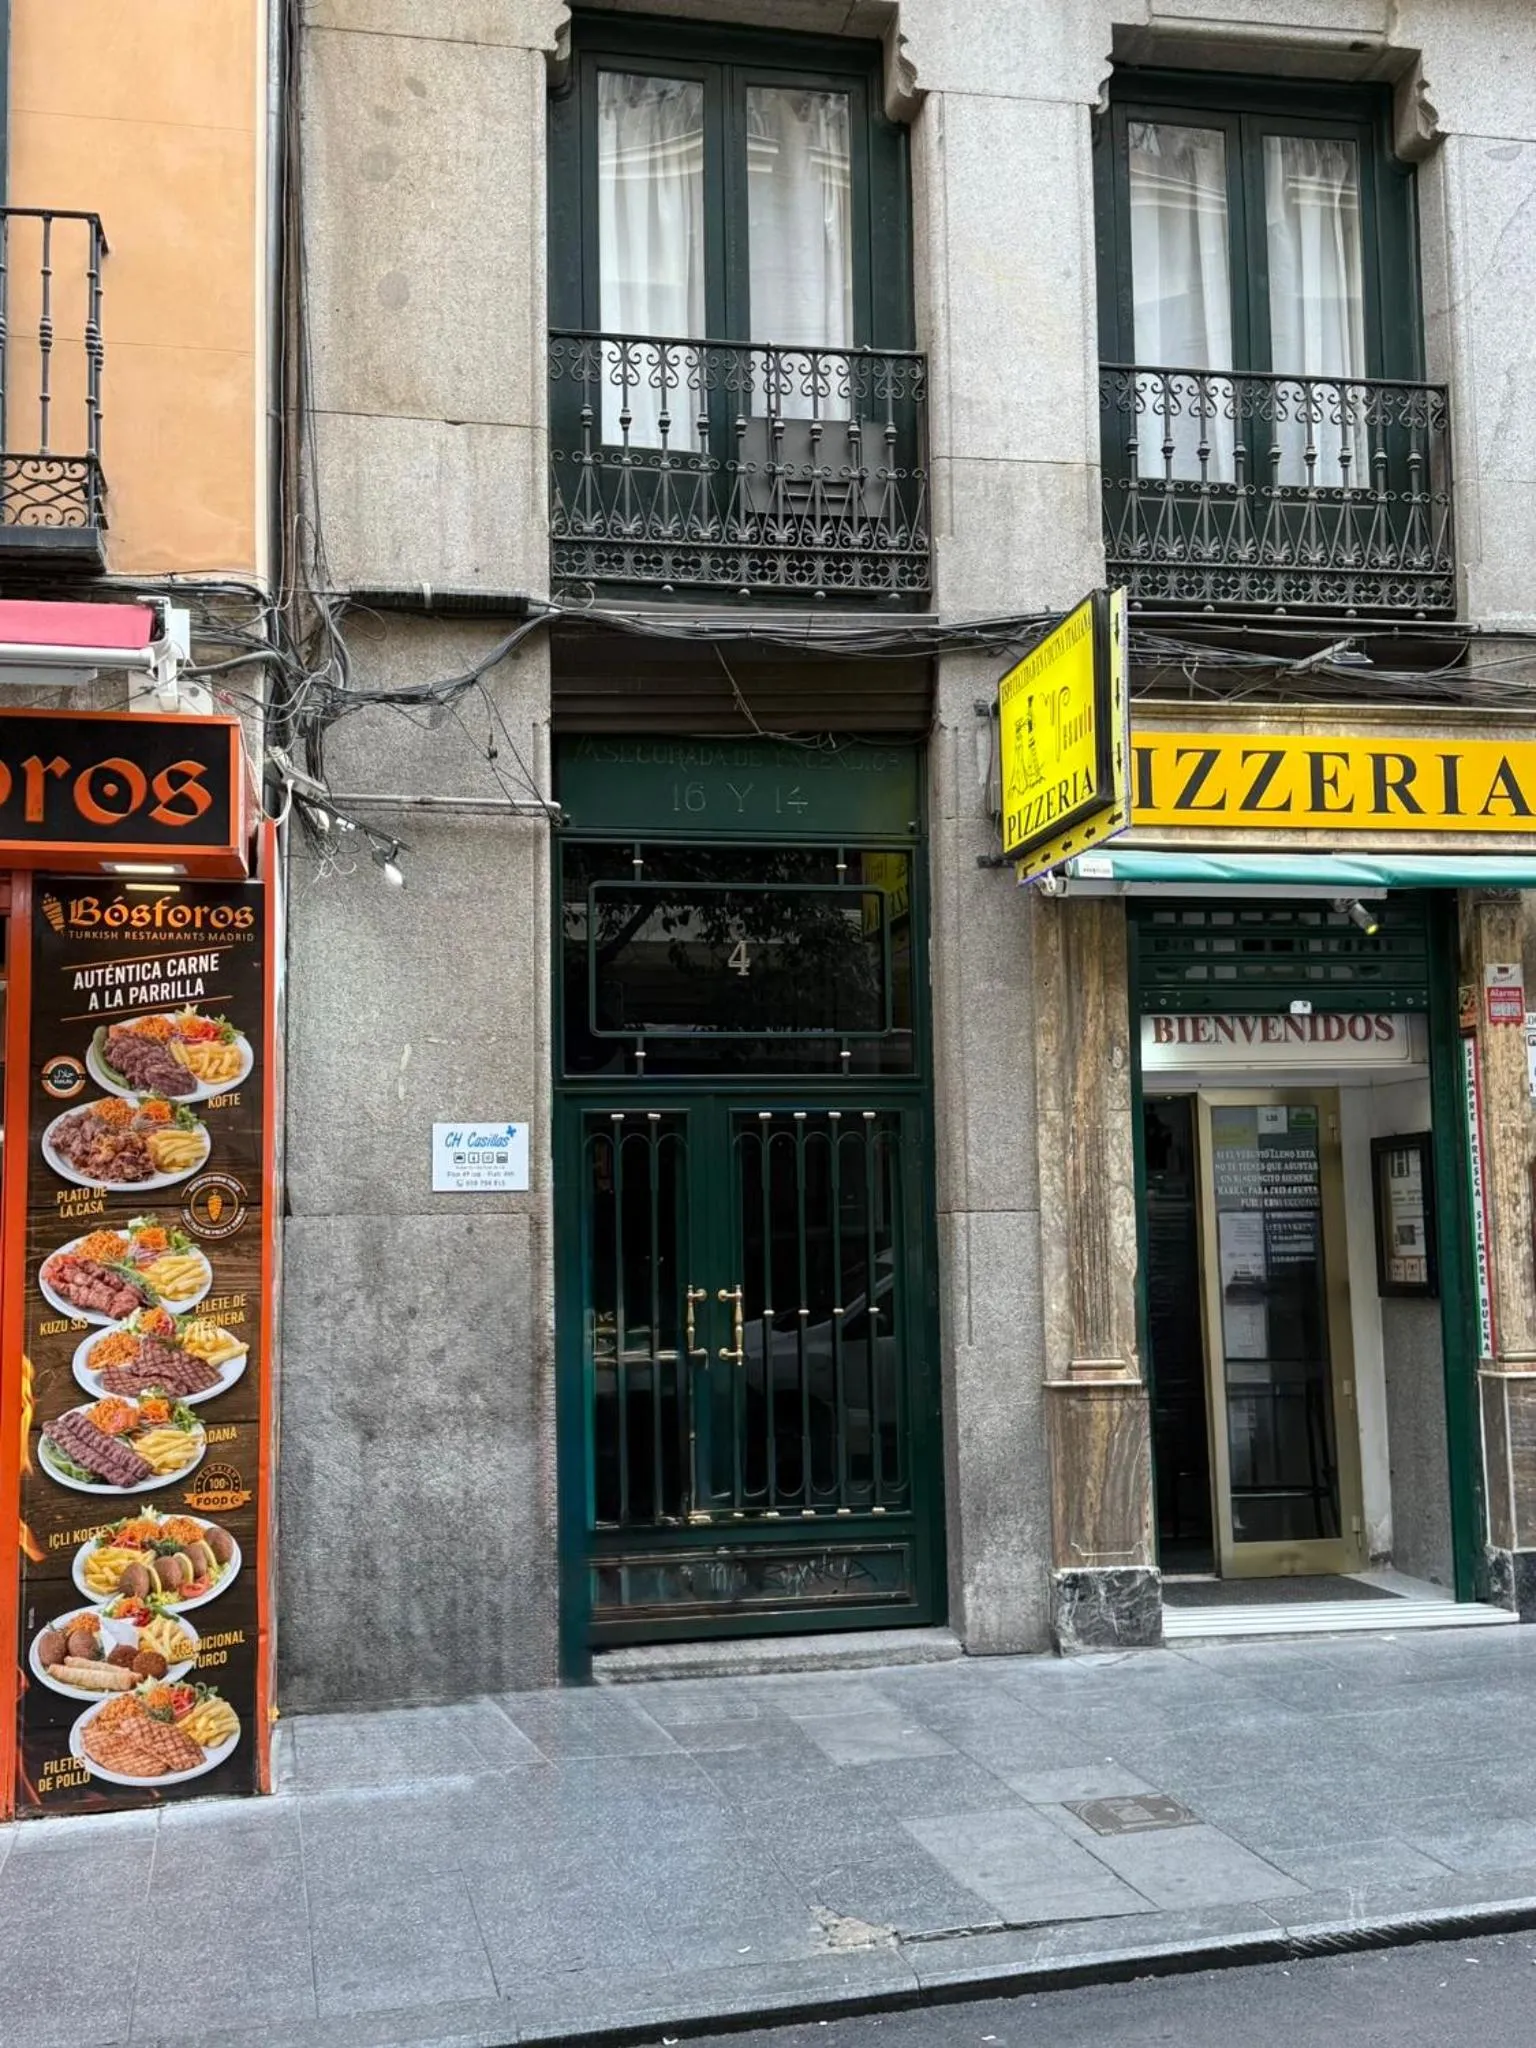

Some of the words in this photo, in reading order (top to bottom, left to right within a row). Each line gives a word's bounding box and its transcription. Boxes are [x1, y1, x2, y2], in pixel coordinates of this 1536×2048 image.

[0, 755, 212, 827] ros
[1132, 747, 1536, 816] IZZERIA
[672, 781, 707, 812] 16
[726, 782, 755, 813] Y
[1007, 764, 1095, 847] PIZZERIA
[69, 895, 255, 929] Bósforos
[69, 930, 118, 940] TURKISH
[208, 932, 255, 942] MADRID
[727, 940, 750, 976] 4
[73, 962, 162, 991] AUTÉNTICA
[167, 953, 220, 977] CARNE
[88, 993, 99, 1011] A
[104, 989, 124, 1009] LA
[129, 978, 205, 1005] PARRILLA
[1152, 1014, 1396, 1046] BIENVENIDOS
[445, 1131, 463, 1148] CH
[57, 1188, 90, 1204] PLATO
[93, 1186, 108, 1199] DE
[60, 1204, 74, 1219] LA
[75, 1201, 104, 1217] CASA
[195, 1296, 230, 1314] FILETE
[232, 1294, 247, 1308] DE
[40, 1319, 68, 1336] KUZU
[202, 1426, 237, 1444] ADANA
[196, 1496, 228, 1506] FOOD
[192, 1650, 228, 1669] TURCO
[38, 1777, 53, 1792] DE
[56, 1771, 91, 1790] POLLO
